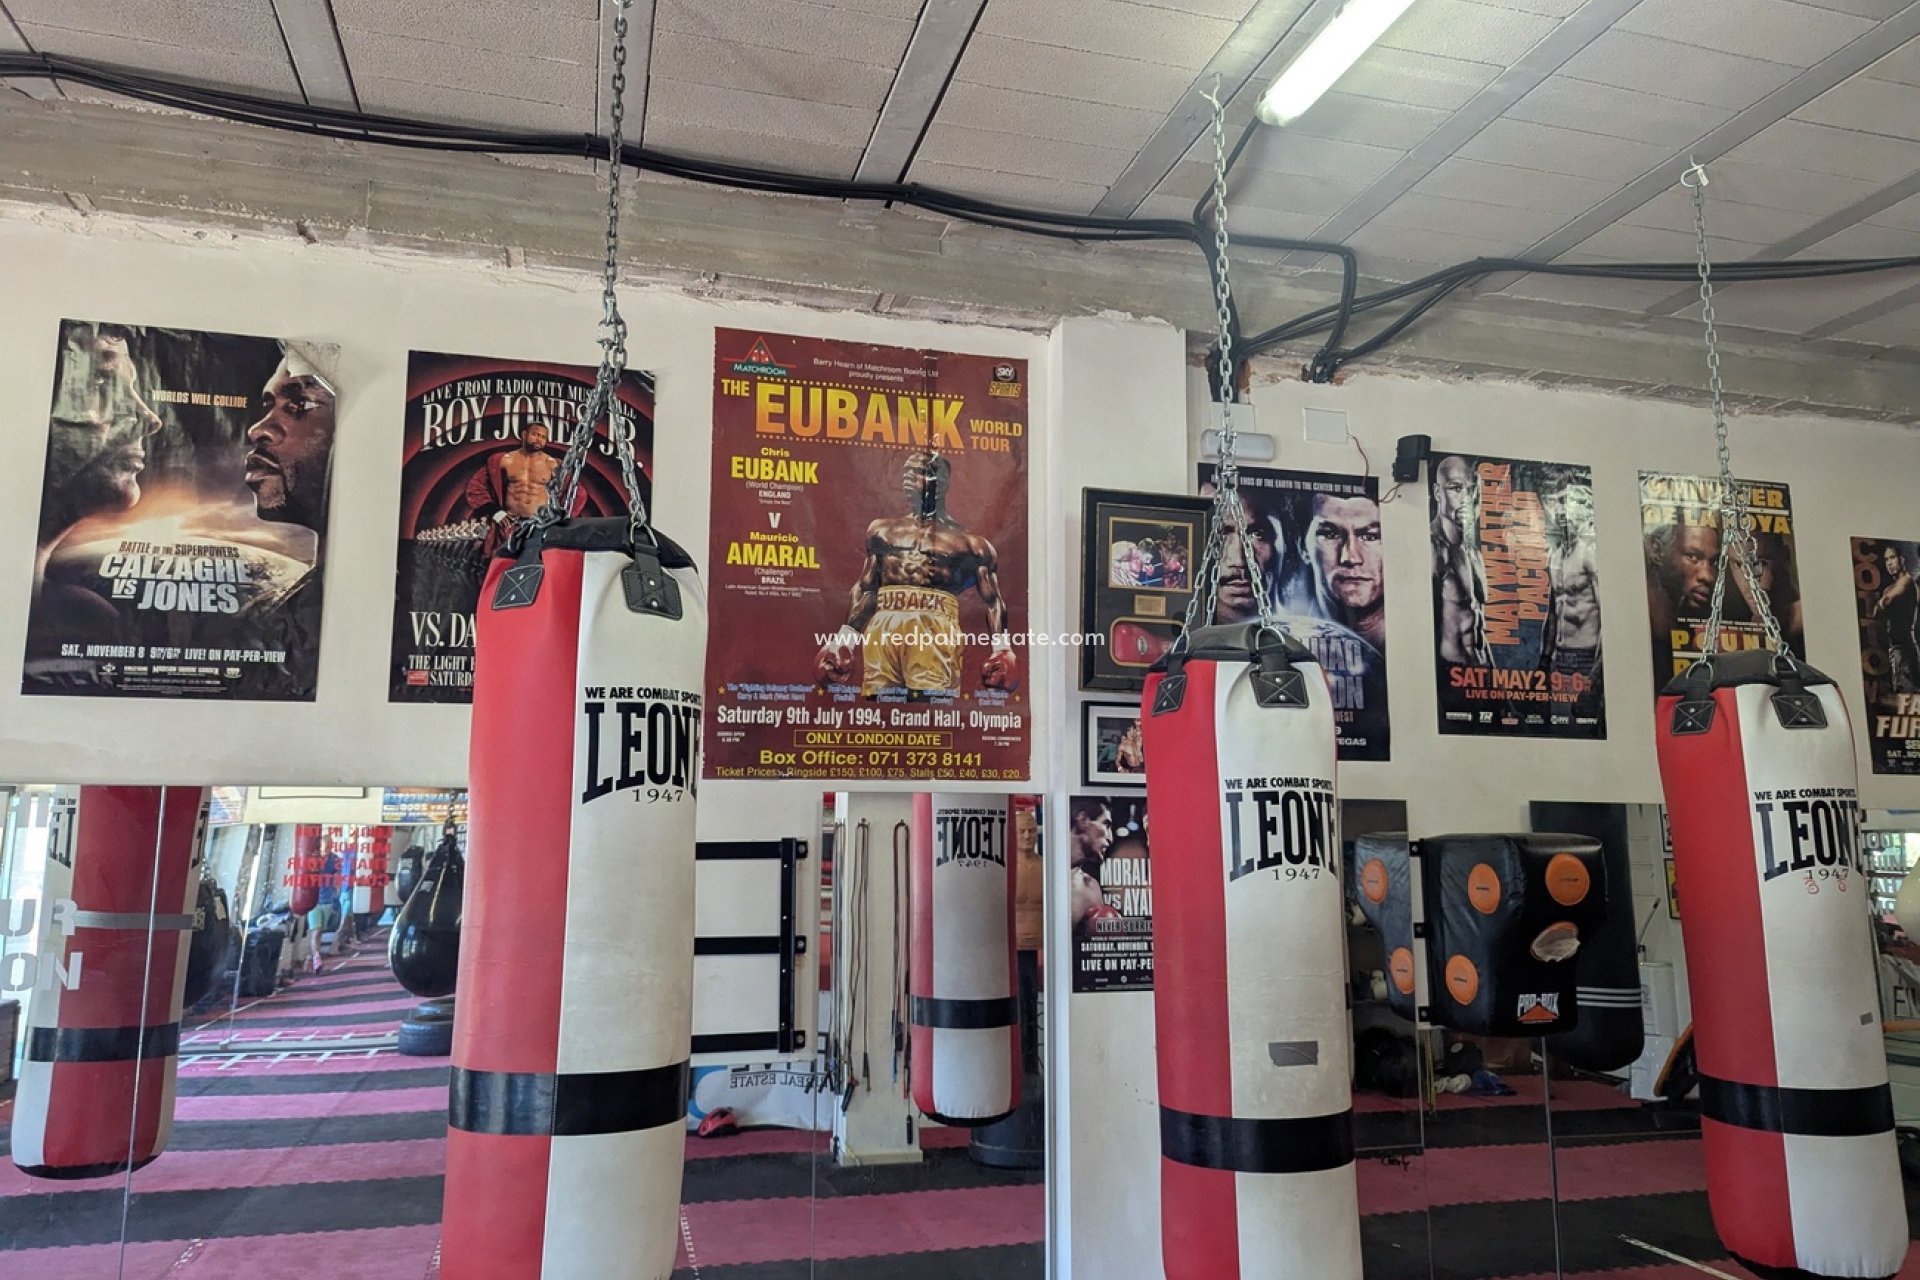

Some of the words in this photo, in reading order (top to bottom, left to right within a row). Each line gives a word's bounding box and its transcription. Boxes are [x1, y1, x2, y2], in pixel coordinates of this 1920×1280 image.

[733, 363, 787, 376] MATCHROOM
[423, 383, 451, 404] LIVE
[457, 379, 491, 398] FROM
[496, 378, 533, 395] RADIO
[537, 379, 564, 399] CITY
[721, 379, 750, 397] THE
[152, 390, 189, 404] WORLDS
[191, 393, 211, 405] WILL
[213, 395, 248, 408] COLLIDE
[421, 395, 491, 452] ROY
[494, 395, 593, 450] JONES
[756, 382, 965, 449] EUBANK
[970, 419, 1023, 437] WORLD
[761, 447, 790, 458] Chris
[970, 436, 1010, 453] TOUR
[731, 456, 819, 484] EUBANK
[758, 490, 791, 499] ENGLAND
[768, 512, 781, 529] V
[1684, 507, 1718, 528] LA
[750, 532, 799, 542] Mauricio
[119, 541, 151, 553] BATTLE
[175, 544, 240, 558] SUPERPOWERS
[726, 542, 820, 569] AMARAL
[1479, 463, 1521, 646] MAYWEATHER
[98, 553, 253, 583] CALZAGHE
[112, 579, 138, 597] VS
[137, 581, 239, 614] JONES
[409, 611, 445, 647] VS.
[1671, 630, 1779, 652] POUN
[87, 645, 134, 658] NOVEMBER
[184, 648, 206, 660] LIVE!
[208, 649, 221, 661] ON
[223, 650, 285, 663] PAY-PER-VIEW
[408, 655, 431, 670] THE
[434, 655, 467, 671] LIGHT
[430, 671, 475, 686] SATURD
[1450, 666, 1489, 688] SAT
[1492, 669, 1533, 690] MAY
[1535, 671, 1547, 691] 2
[585, 686, 606, 699] WE
[609, 687, 633, 699] ARE
[637, 687, 680, 701] COMBAT
[1466, 689, 1488, 699] LIVE
[1490, 690, 1505, 700] ON
[1506, 690, 1579, 703] PAY-PER-VIEW
[717, 705, 783, 728] Saturday
[786, 706, 810, 725] 9th
[814, 707, 843, 729] July
[848, 708, 886, 729] 1994,
[890, 708, 930, 727] Grand
[934, 710, 965, 730] Hall,
[969, 710, 1022, 732] Olympia
[806, 732, 843, 745] ONLY
[847, 732, 904, 746] LONDON
[907, 733, 942, 746] DATE
[582, 702, 702, 804] LEONE
[760, 750, 796, 765] Box
[802, 750, 863, 765] Office:
[869, 751, 899, 766] 071
[906, 752, 937, 766] 373
[942, 752, 982, 766] 8141
[716, 766, 744, 777] Ticket
[787, 767, 827, 779] Ringside
[910, 768, 934, 778] Stalls
[1225, 779, 1243, 789] WE
[1246, 777, 1268, 789] ARE
[1270, 777, 1310, 788] COMBAT
[632, 788, 684, 804] 1947
[1754, 791, 1772, 800] WE
[1775, 789, 1797, 799] ARE
[1799, 788, 1835, 798] COMBAT
[1225, 790, 1338, 882] LEONE
[1755, 799, 1863, 882] LEONE
[1272, 868, 1320, 882] 1947
[1804, 868, 1849, 881] 1947
[1104, 893, 1121, 910] VS
[1081, 959, 1102, 971] LIVE
[1105, 959, 1118, 971] ON
